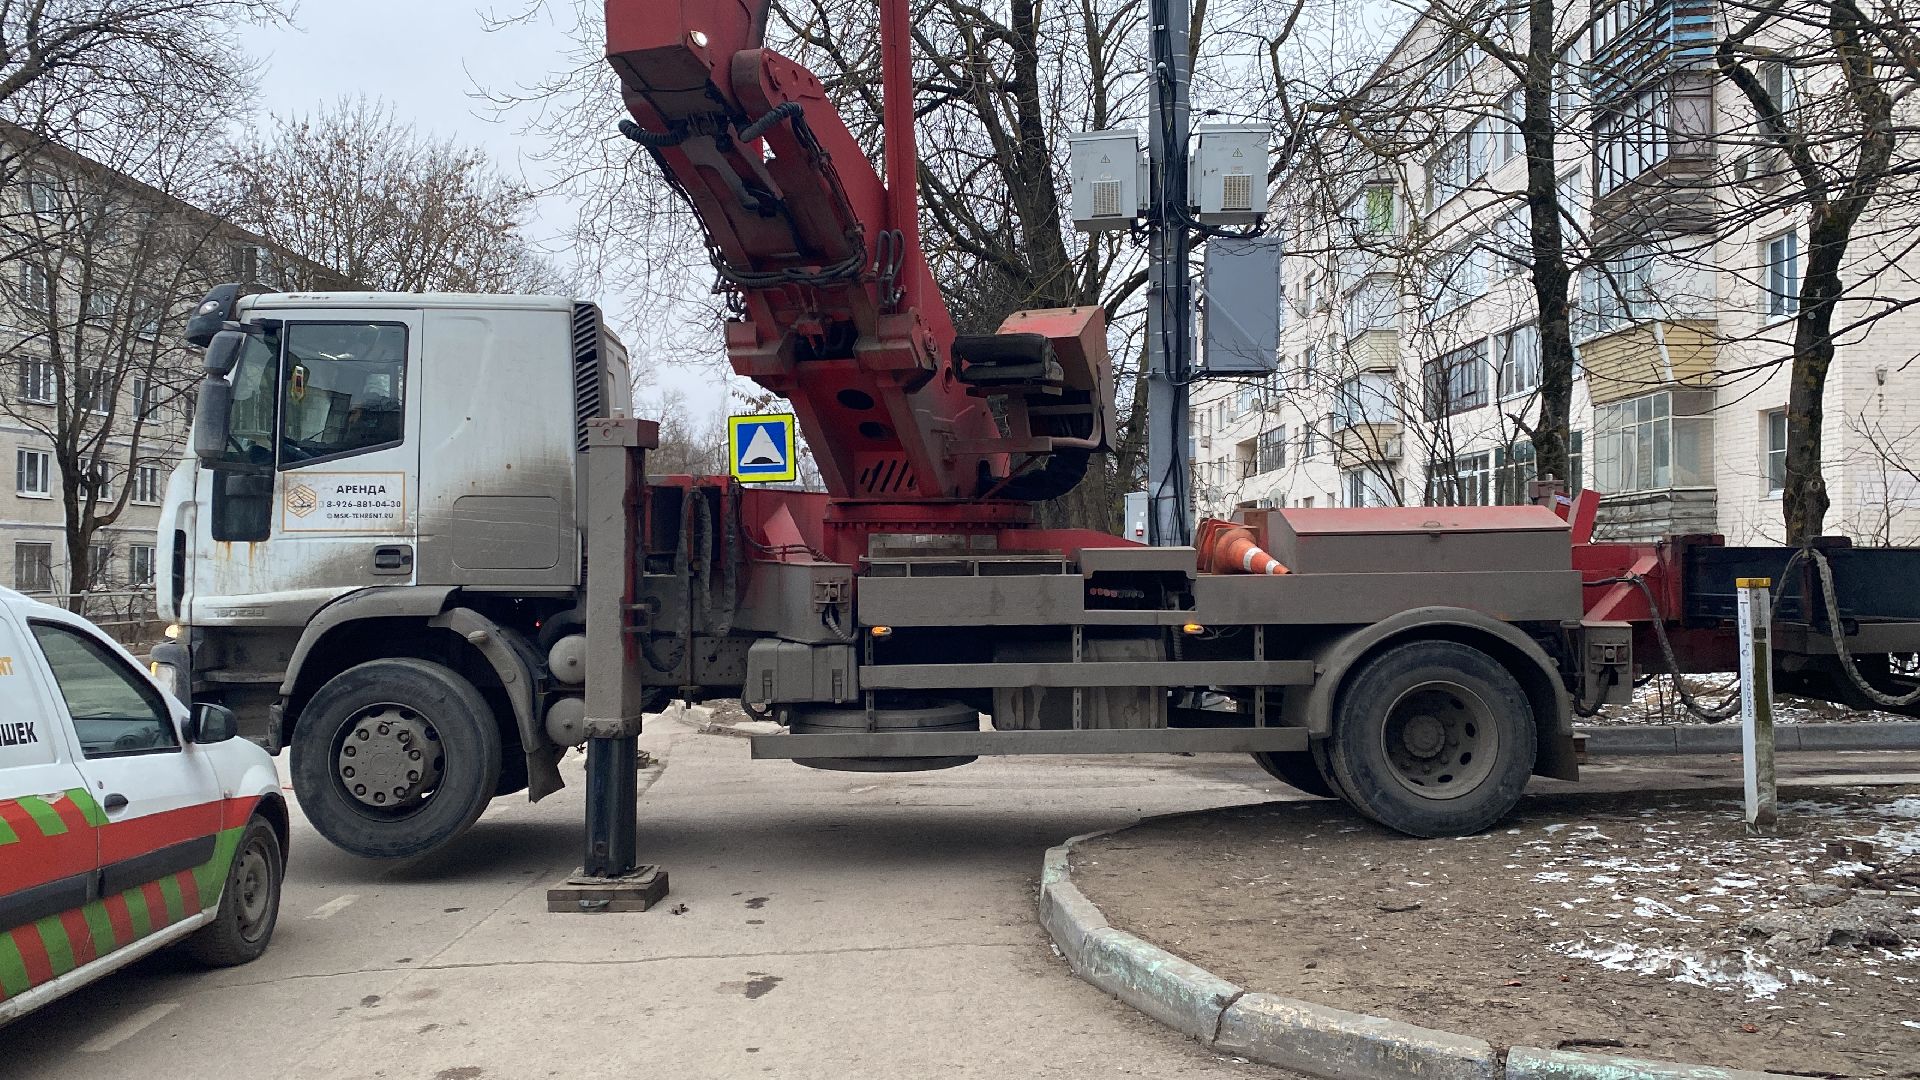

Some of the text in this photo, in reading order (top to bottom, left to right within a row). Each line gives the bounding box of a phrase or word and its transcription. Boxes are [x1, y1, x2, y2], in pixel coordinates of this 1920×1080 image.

[336, 485, 386, 495] АРЕНДА
[326, 500, 401, 508] 8-926-881-04-30
[0, 721, 38, 747] ШЕК
